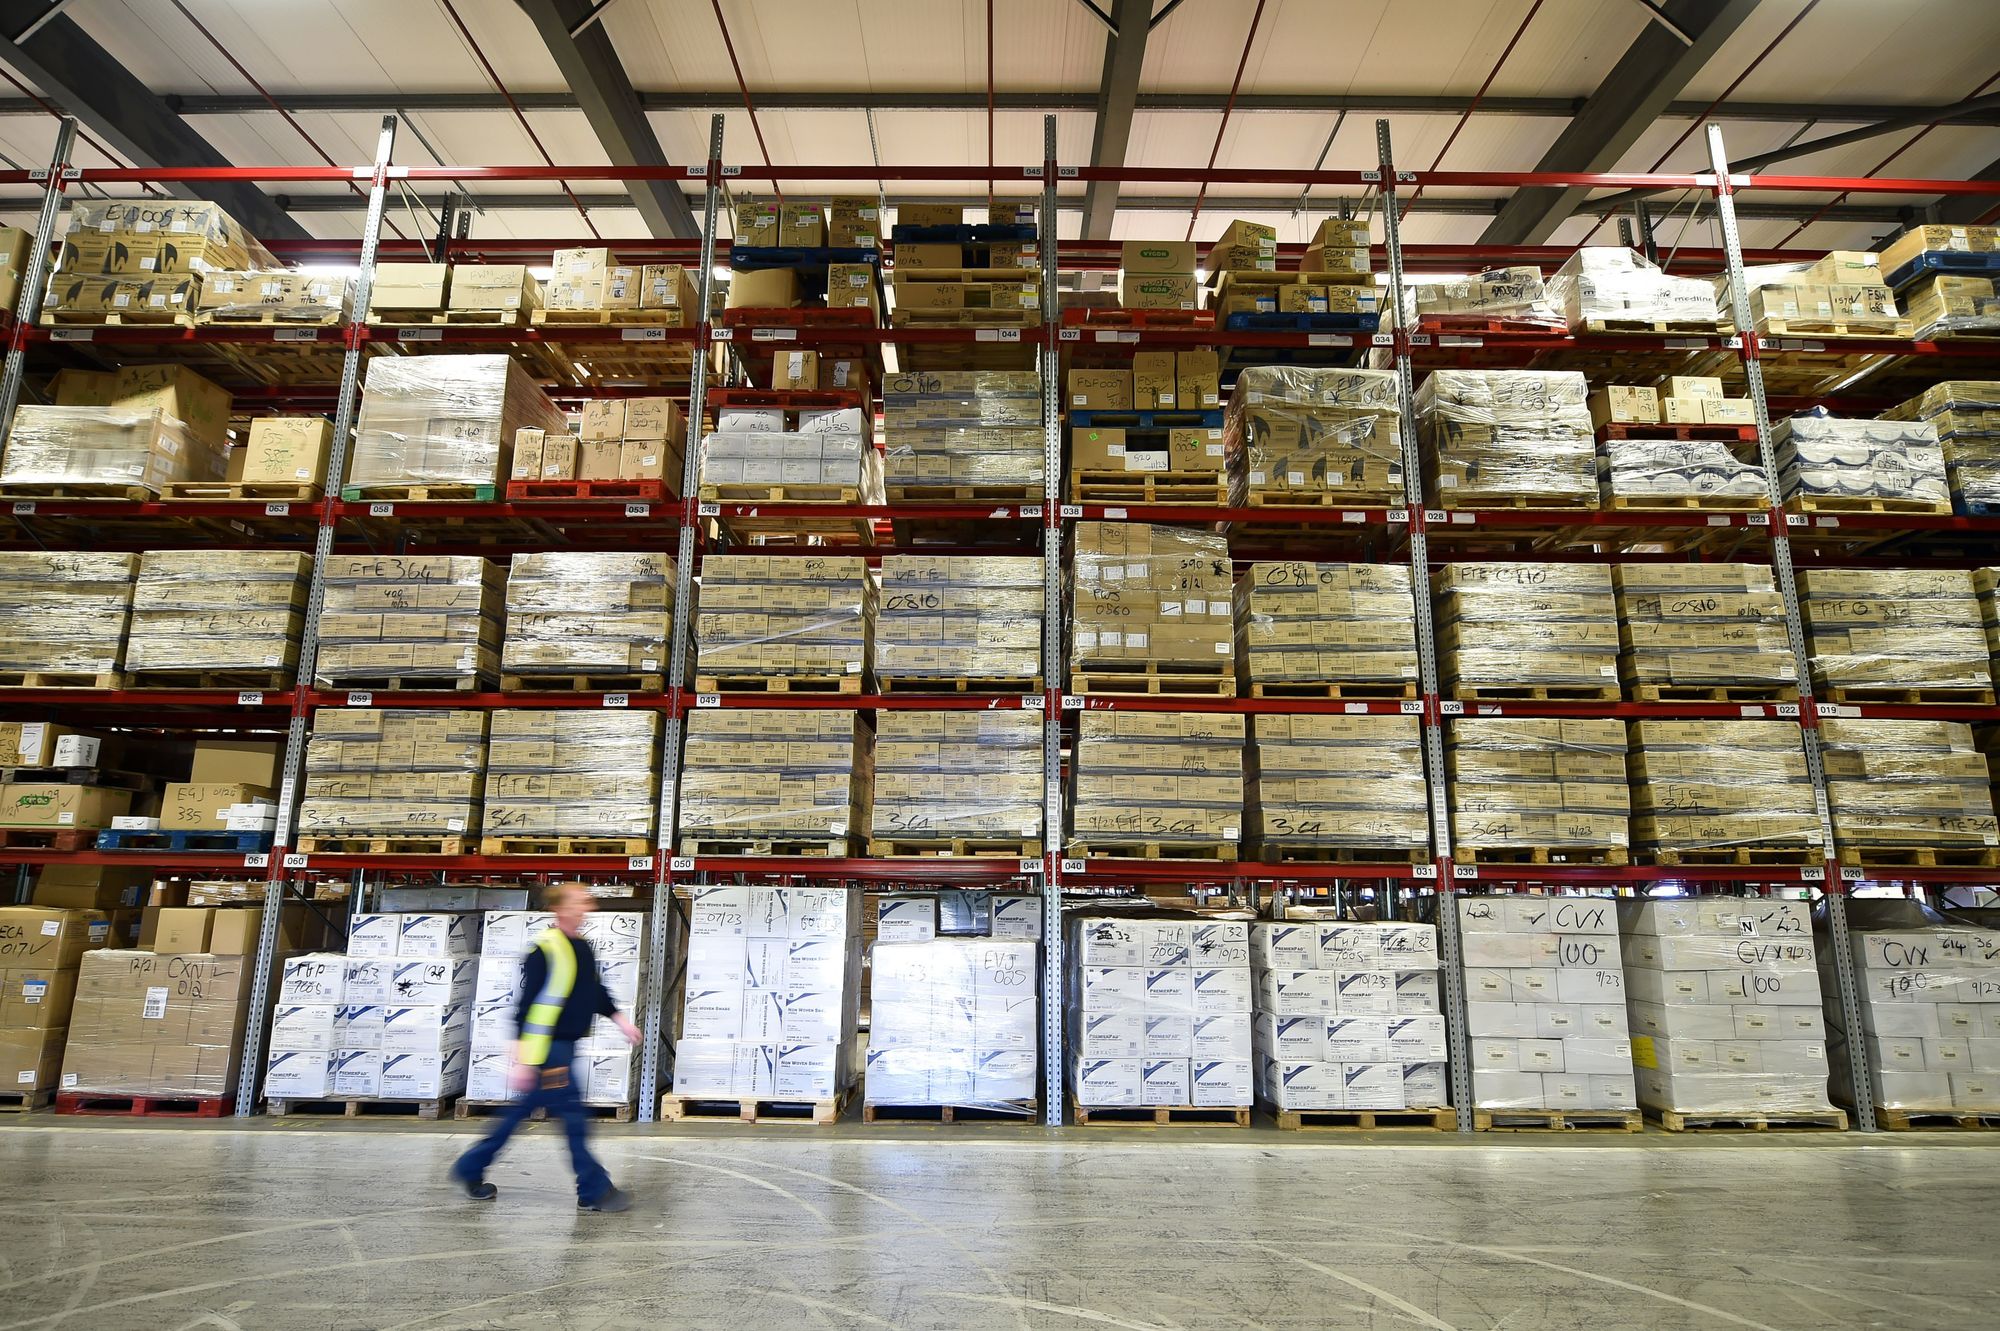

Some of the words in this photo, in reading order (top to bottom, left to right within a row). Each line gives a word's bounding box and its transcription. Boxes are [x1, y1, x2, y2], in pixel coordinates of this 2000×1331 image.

[714, 329, 731, 338] 047
[1180, 376, 1199, 386] FVG
[808, 412, 841, 427] THP
[815, 422, 850, 433] 4035
[1134, 454, 1152, 463] 520
[373, 505, 389, 513] 058
[628, 506, 645, 514] 053
[701, 506, 717, 514] 048
[1063, 508, 1080, 516] 038
[1389, 512, 1406, 520] 033
[1750, 515, 1766, 523] 023
[1789, 516, 1805, 524] 018
[1180, 559, 1204, 570] 390
[349, 561, 387, 576] FTE
[391, 559, 434, 584] 364
[1355, 568, 1372, 576] 400
[1181, 575, 1204, 589] 8/21
[886, 594, 940, 610] 0810
[1671, 598, 1716, 613] 0810
[1737, 602, 1762, 617] 10/23
[1096, 604, 1131, 616] 0560
[1723, 628, 1745, 641] 400
[241, 694, 258, 702] 062
[351, 695, 368, 703] 059
[608, 696, 625, 704] 052
[699, 696, 717, 705] 049
[1025, 698, 1042, 706] 042
[1065, 698, 1082, 706] 039
[1403, 703, 1420, 711] 032
[1779, 706, 1796, 714] 022
[1820, 706, 1837, 714] 019
[1181, 755, 1207, 774] 10/23
[178, 806, 203, 824] 335
[408, 811, 438, 823] 10/23
[793, 815, 828, 829] 10/23
[1089, 816, 1115, 832] 9/23
[1147, 816, 1202, 837] 364
[1271, 818, 1328, 838] 364
[1471, 821, 1514, 839] 364
[1568, 825, 1593, 838] 11/23
[1700, 827, 1727, 838] 10/23
[247, 857, 264, 865] 061
[287, 857, 304, 865] 060
[632, 859, 649, 867] 051
[673, 860, 691, 868] 050
[1022, 862, 1040, 870] 041
[1065, 862, 1082, 870] 040
[1416, 867, 1433, 876] 031
[1457, 868, 1474, 876] 030
[1804, 869, 1820, 877] 021
[1844, 869, 1861, 877] 020
[707, 913, 743, 927] 07/23
[1556, 904, 1605, 929] CVX
[621, 917, 637, 930] 32
[1742, 921, 1753, 932] N
[1776, 917, 1807, 934] 42
[0, 925, 24, 939] ECA
[1115, 930, 1132, 942] 32
[1156, 927, 1186, 943] THP
[1226, 926, 1243, 938] 32
[1417, 936, 1430, 948] 32
[1974, 937, 1993, 948] 36
[1558, 936, 1598, 967] 100
[1736, 940, 1782, 964] CVX
[1786, 946, 1813, 961] 9/23
[1942, 938, 1966, 958] 614
[1218, 949, 1248, 962] 10/23
[1883, 941, 1929, 967] CVX
[129, 957, 157, 978] 12/21
[168, 957, 203, 979] CXN
[428, 965, 446, 981] 28
[1357, 974, 1387, 989] 10/23
[1595, 970, 1620, 987] 9/23
[1740, 975, 1781, 998] 100
[1971, 982, 2000, 998] 9/23
